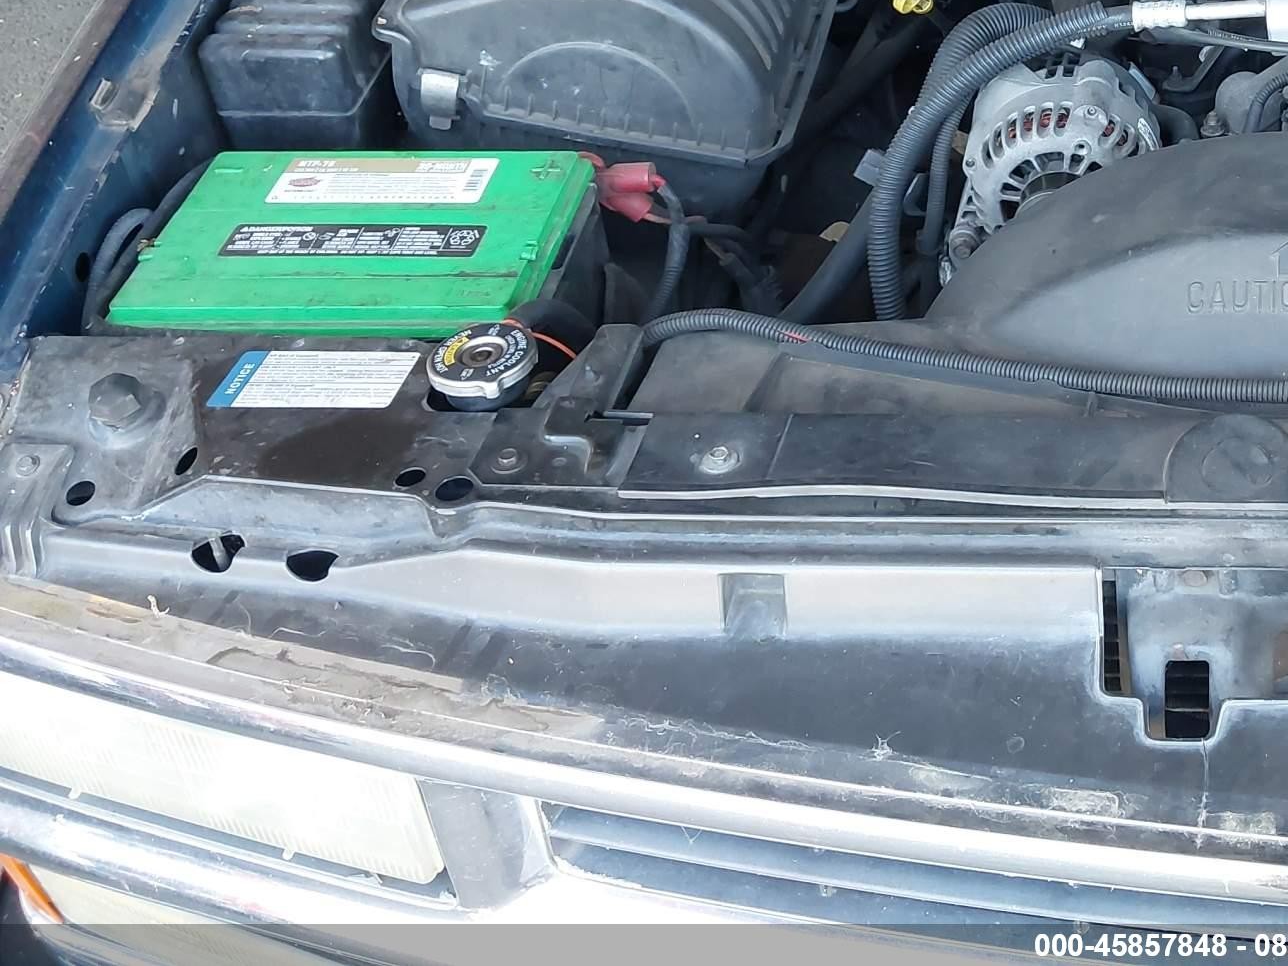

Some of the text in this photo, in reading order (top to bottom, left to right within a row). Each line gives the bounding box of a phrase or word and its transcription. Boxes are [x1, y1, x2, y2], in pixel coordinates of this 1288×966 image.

[510, 329, 528, 350] ENGINE
[485, 350, 525, 377] COOLANT
[224, 363, 256, 395] NOTICE
